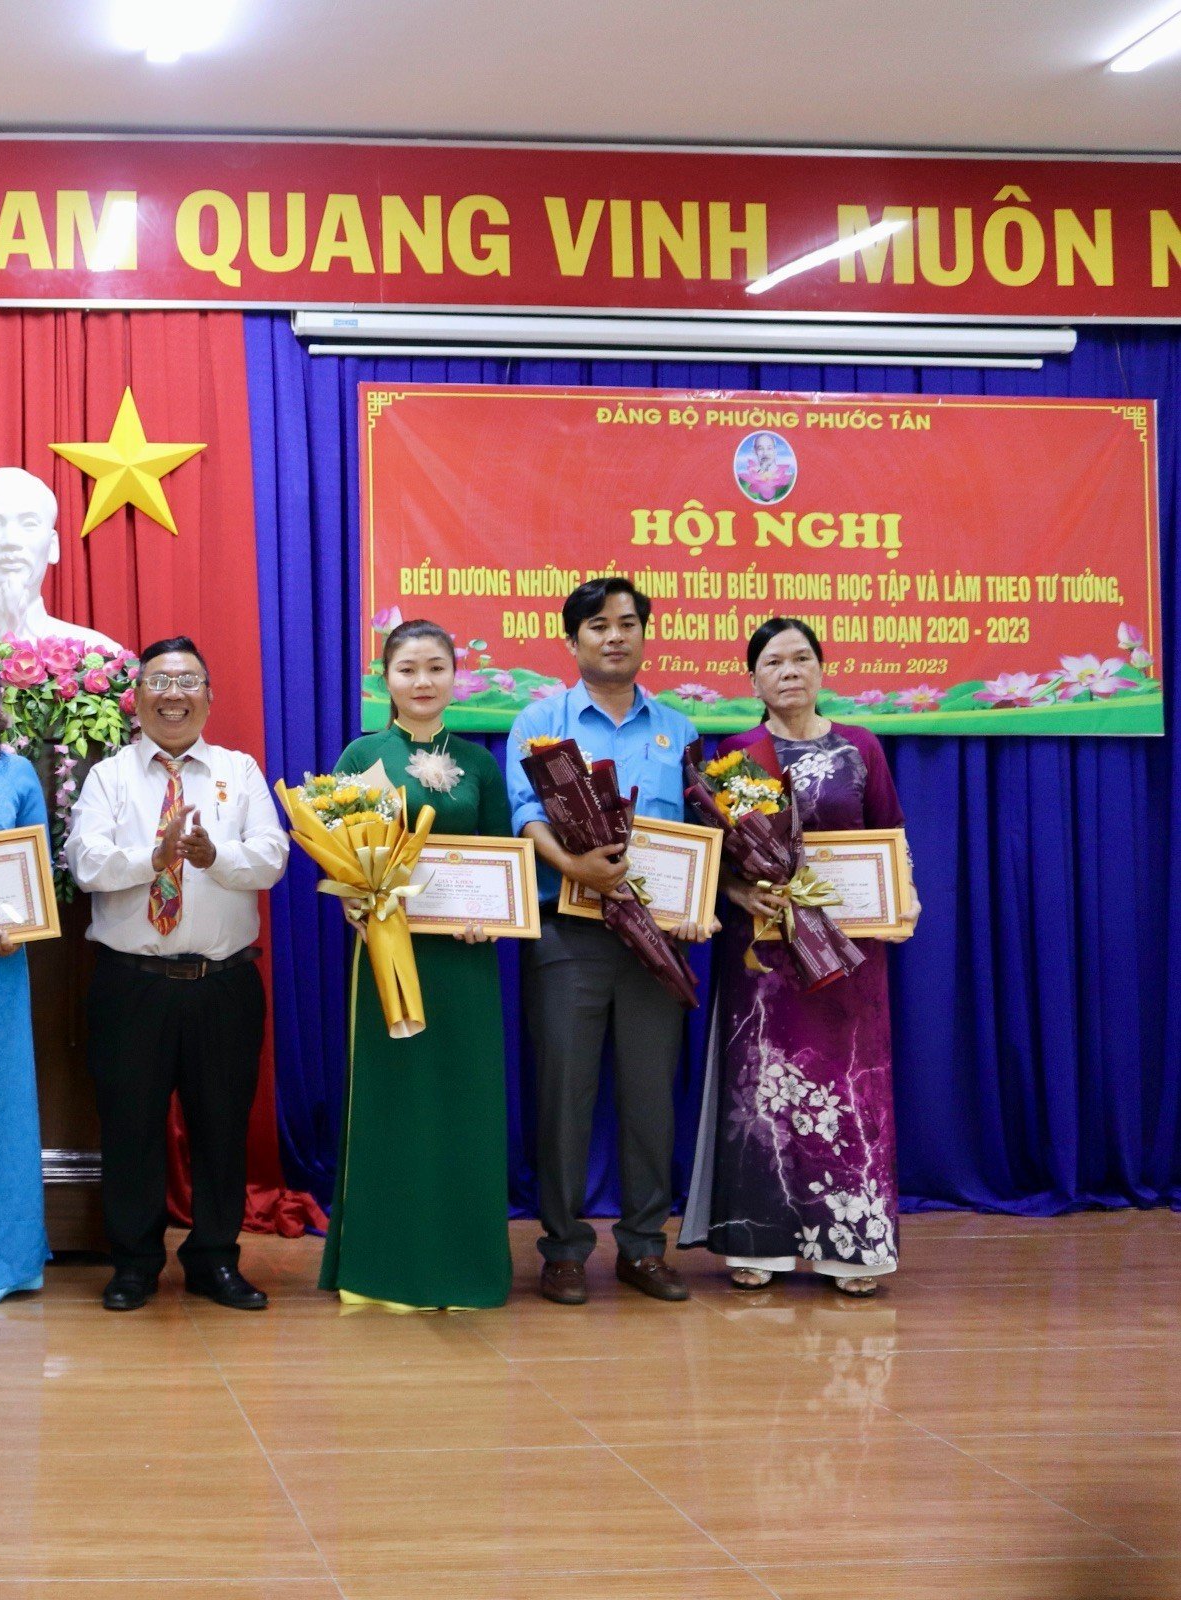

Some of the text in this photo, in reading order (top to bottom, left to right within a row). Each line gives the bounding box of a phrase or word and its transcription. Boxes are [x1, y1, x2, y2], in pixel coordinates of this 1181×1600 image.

[175, 189, 510, 287] QUANG
[545, 196, 769, 282] VINH
[837, 185, 1113, 287] MUÔN
[596, 402, 931, 430] ĐẢNG BỘ PHƯỜNG PHƯỚC TÂN
[631, 499, 903, 559] HỘI NGHỊ
[400, 557, 442, 596] BIỂU
[448, 567, 511, 597] DƯƠNG
[516, 564, 580, 597] NHỮNG
[634, 565, 678, 598] HÌNH
[683, 568, 722, 599] TIÊU
[727, 562, 768, 600] BIỂU
[773, 572, 832, 600] TRONG
[837, 574, 873, 607] HỌC
[877, 569, 911, 607] TẬP
[916, 570, 940, 602] VÀ
[944, 570, 981, 602] LÀM
[986, 576, 1031, 602] THEO
[1035, 574, 1059, 602] TƯ
[1061, 568, 1124, 607] TƯỞNG,
[503, 611, 540, 645] ĐẠO
[660, 608, 710, 641] CÁCH
[715, 605, 738, 641] HỒ
[832, 616, 868, 643] GIAI
[873, 617, 922, 648] ĐOẠN
[927, 617, 969, 644] 2020
[986, 617, 1030, 644] 2023
[657, 656, 700, 675] Tân,
[844, 658, 856, 674] 3
[860, 658, 901, 674] năm
[906, 658, 949, 674] 2023
